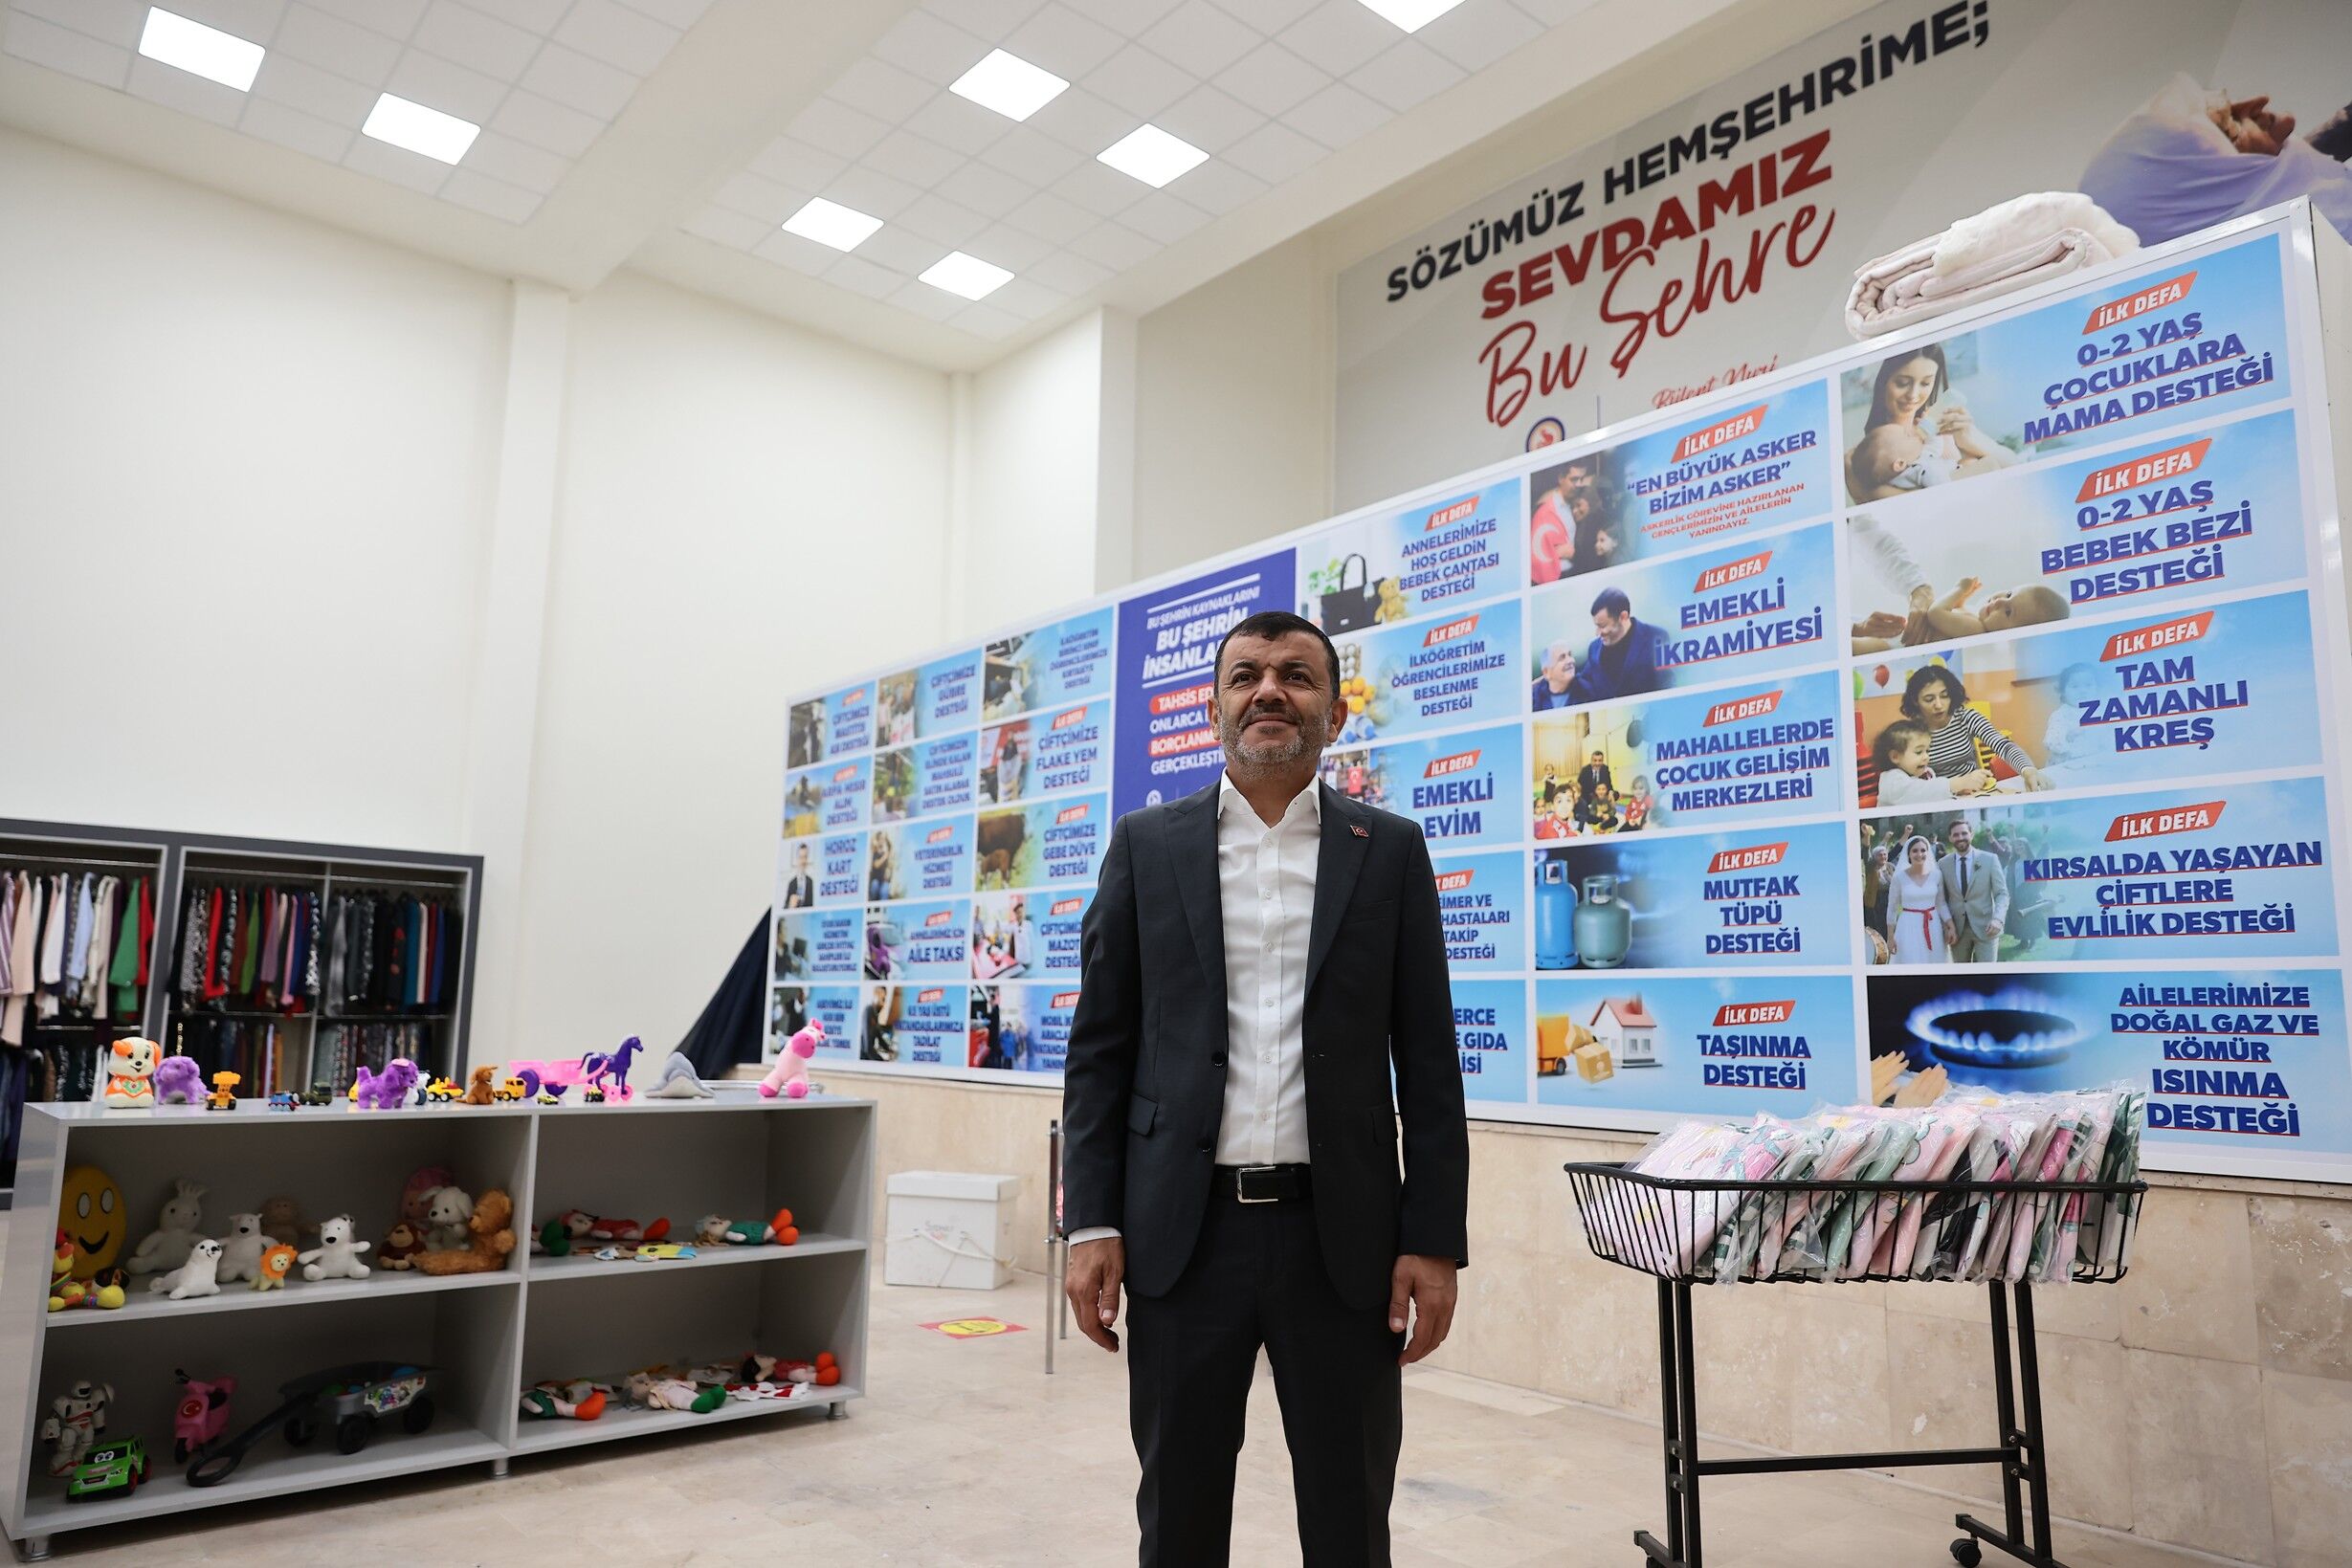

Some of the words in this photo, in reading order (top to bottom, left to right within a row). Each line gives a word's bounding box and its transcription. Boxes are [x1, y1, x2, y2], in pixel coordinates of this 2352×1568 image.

[1387, 180, 1585, 302] SÖZÜMÜZ
[1604, 0, 1990, 205] HEMŞEHRİME;
[1481, 129, 1832, 319] SEVDAMIZ
[1478, 320, 1587, 427] Bu
[1600, 204, 1835, 378] Şehre
[2098, 306, 2128, 327] İLK
[2134, 283, 2184, 318] DEFA
[2077, 332, 2131, 365] 0-2
[2139, 312, 2202, 348] YAŞ
[2044, 333, 2246, 410] ÇOCUKLARA
[2024, 396, 2126, 445] MAMA
[2132, 351, 2274, 415] DESTEĞİ
[1684, 432, 1708, 456] İLK
[1713, 418, 1754, 447] DEFA
[1670, 453, 1736, 489] BÜYÜK
[1741, 430, 1817, 469] ASKER
[2096, 472, 2130, 496] İLK
[2136, 451, 2193, 483] DEFA
[1448, 503, 1473, 522] DEFA
[1650, 484, 1704, 515] BİZİM
[1687, 501, 1735, 519] GÖREVİNE
[1737, 483, 1805, 507] HAZIRLANAN
[1724, 511, 1738, 520] VE
[1740, 497, 1791, 517] AİLELERİN
[2076, 498, 2131, 530] 0-2
[2139, 479, 2213, 517] YAŞ
[1401, 518, 1497, 558] ANNELERİMİZE
[2042, 530, 2157, 574] BEBEK
[2166, 499, 2252, 549] BEZİ
[1410, 555, 1437, 572] HOŞ
[1439, 540, 1486, 563] GELDİN
[1400, 569, 1440, 590] BEBEK
[1443, 553, 1499, 582] ÇANTASI
[1705, 570, 1726, 588] İLK
[1729, 560, 1762, 582] DEFA
[2070, 544, 2224, 604] DESTEĞİ
[1422, 576, 1475, 602] DESTEĞİ
[1681, 577, 1785, 629] EMEKLİ
[1156, 626, 1181, 651] BU
[1447, 622, 1472, 639] DEFA
[1654, 607, 1822, 669] İKRAMİYESİ
[2116, 634, 2147, 657] İLK
[2151, 620, 2199, 650] DEFA
[1409, 640, 1485, 668] İLKÖĞRETİM
[1392, 653, 1505, 688] ÖĞRENCİLERİMİZE
[2116, 655, 2195, 691] TAM
[1413, 678, 1478, 700] BESLENME
[2078, 680, 2248, 725] ZAMANLI
[1422, 696, 1473, 716] DESTEĞİ
[1714, 706, 1734, 723] İLK
[1739, 699, 1771, 718] DEFA
[1150, 710, 1203, 734] ONLARCA
[2115, 718, 2214, 753] KREŞ
[1038, 724, 1098, 752] ÇİFTÇİMİZE
[1656, 718, 1833, 761] MAHALLELERDE
[1035, 752, 1071, 771] FLAKE
[1074, 747, 1098, 763] YEM
[1431, 761, 1447, 776] İLK
[1448, 755, 1474, 772] DEFA
[1656, 760, 1731, 788] ÇOCUK
[1736, 745, 1830, 779] GELİŞİM
[1044, 764, 1090, 788] DESTEĞİ
[1413, 772, 1493, 808] EMEKLİ
[1672, 777, 1811, 810] MERKEZLERİ
[1425, 808, 1480, 838] EVİM
[2121, 815, 2153, 837] İLK
[2158, 808, 2209, 831] DEFA
[1049, 858, 1088, 877] DESTEĞİ
[1719, 853, 1741, 871] İLK
[1743, 847, 1777, 867] DEFA
[2023, 849, 2163, 882] KIRSALDA
[2170, 841, 2323, 874] YAŞAYAN
[1442, 874, 1467, 889] DEFA
[1704, 874, 1800, 899] MUTFAK
[2096, 878, 2233, 908] ÇİFTLERE
[1476, 894, 1492, 906] VE
[1720, 901, 1782, 925] TÜPÜ
[1442, 910, 1510, 925] HASTALARI
[2049, 908, 2161, 939] EVLİLİK
[2162, 901, 2296, 934] DESTEĞİ
[1444, 927, 1478, 942] TAKİP
[1706, 928, 1800, 954] DESTEĞİ
[908, 943, 931, 962] AİLE
[933, 941, 965, 961] TAKSİ
[2119, 982, 2311, 1007] AİLELERİMİZE
[1724, 1005, 1745, 1024] İLK
[1750, 1005, 1785, 1022] DEFA
[2111, 1007, 2206, 1033] DOĞAL
[2211, 1013, 2275, 1035] GAZ
[2279, 1014, 2319, 1035] VE
[1464, 1032, 1507, 1050] GIDA
[1697, 1033, 1810, 1058] TAŞINMA
[2163, 1036, 2272, 1063] KÖMÜR
[1704, 1062, 1806, 1090] DESTEĞİ
[2153, 1069, 2290, 1099] ISINMA
[2147, 1102, 2300, 1137] DESTEĞİ
